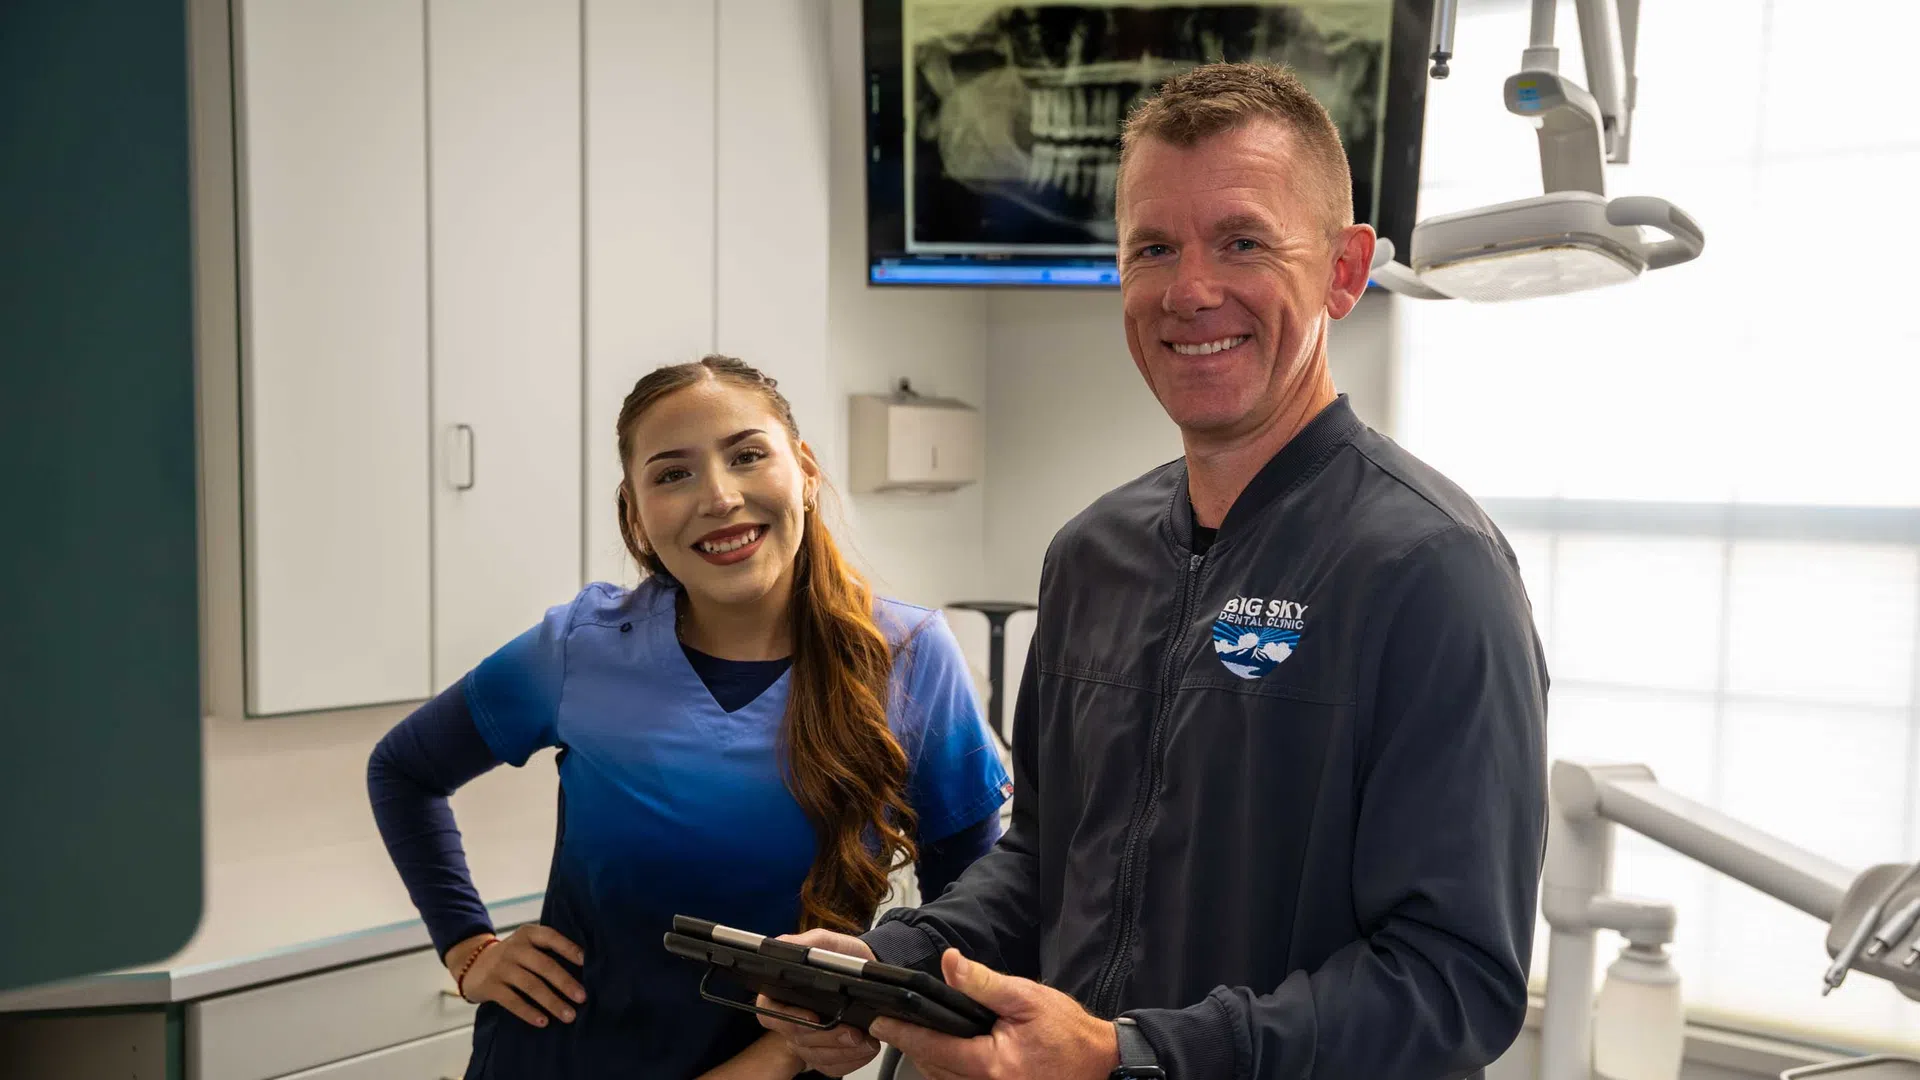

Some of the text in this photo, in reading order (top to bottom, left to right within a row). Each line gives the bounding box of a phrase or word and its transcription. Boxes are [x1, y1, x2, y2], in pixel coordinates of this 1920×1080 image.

[1223, 598, 1309, 620] BIG SKY
[1218, 611, 1305, 630] DENTAL CLINIC
